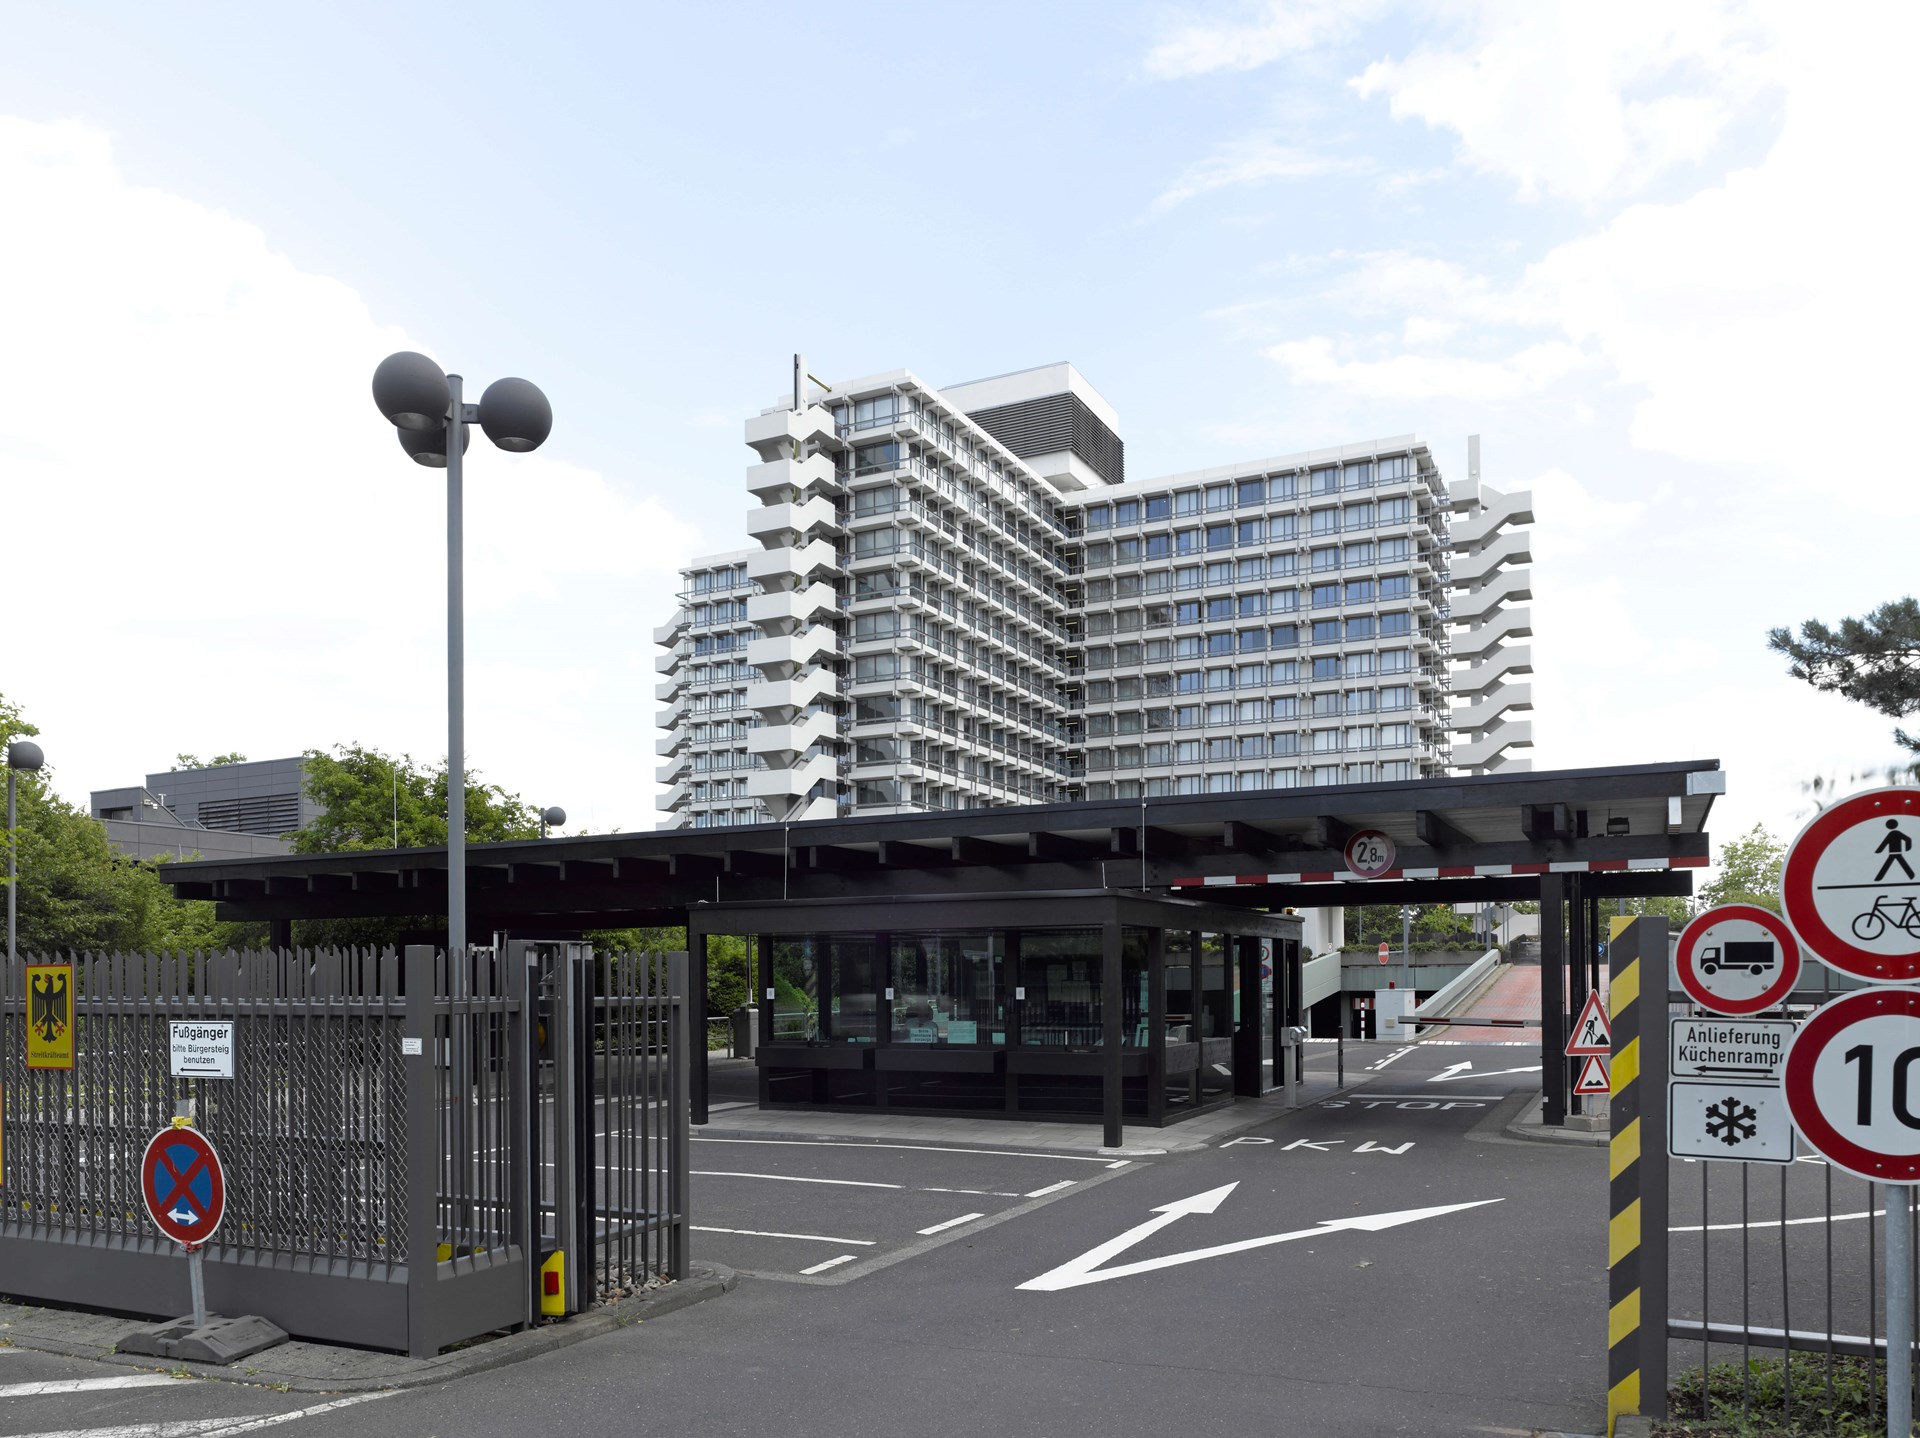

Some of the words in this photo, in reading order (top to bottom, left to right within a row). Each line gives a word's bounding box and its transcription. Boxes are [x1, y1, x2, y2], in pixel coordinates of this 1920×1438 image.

[172, 1026, 228, 1041] Fußgänger
[1686, 1026, 1780, 1050] Anlieferung
[172, 1044, 187, 1053] bitte
[187, 1044, 230, 1055] Bürgersteig
[183, 1056, 216, 1064] benutzen
[1319, 1100, 1486, 1110] STOP
[1219, 1136, 1416, 1155] PKW
